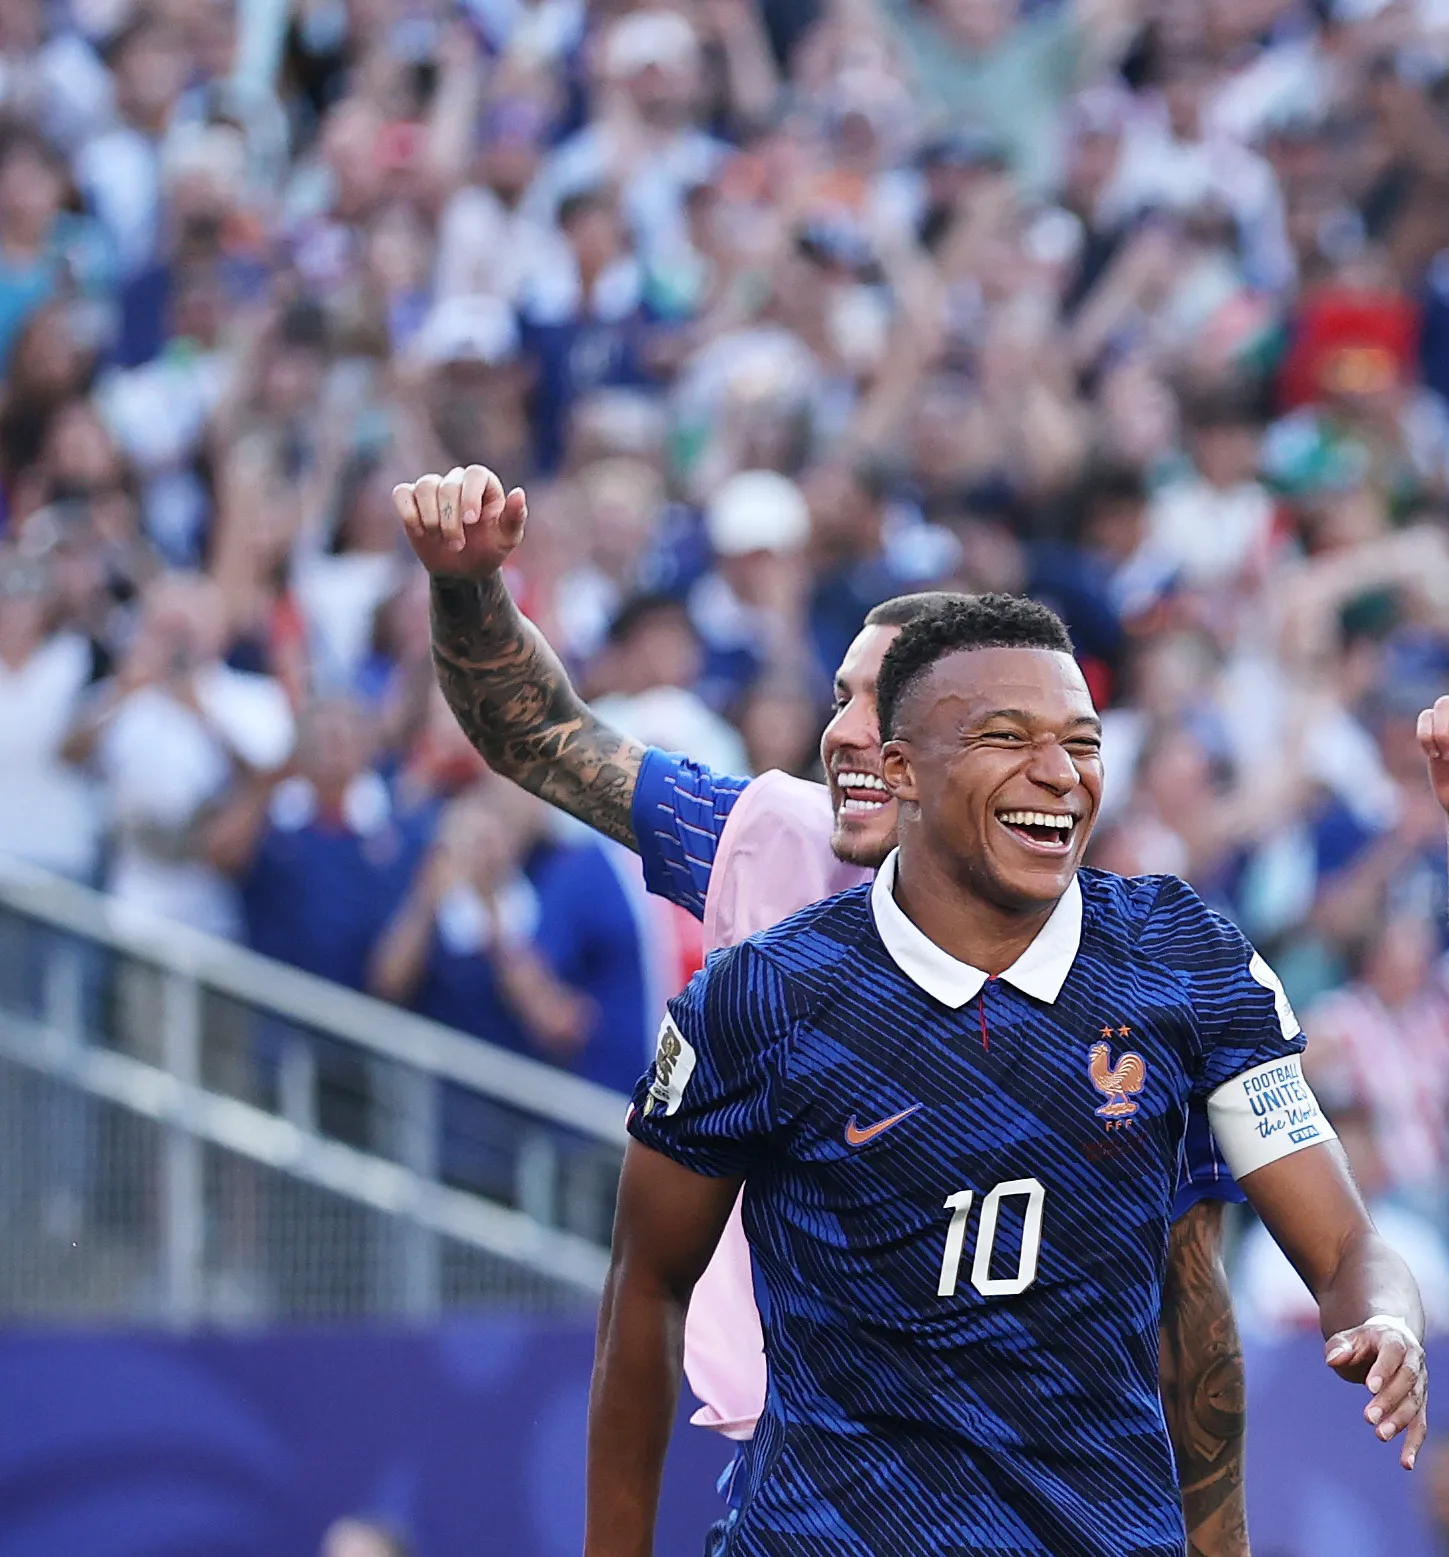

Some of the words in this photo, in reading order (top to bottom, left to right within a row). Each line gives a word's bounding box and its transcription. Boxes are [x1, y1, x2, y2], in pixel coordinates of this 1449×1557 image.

[1243, 1063, 1299, 1095] FOOTBALL
[1249, 1080, 1308, 1117] UNITES
[1105, 1119, 1133, 1132] FFF
[1255, 1117, 1286, 1138] the
[937, 1178, 1046, 1297] 10
